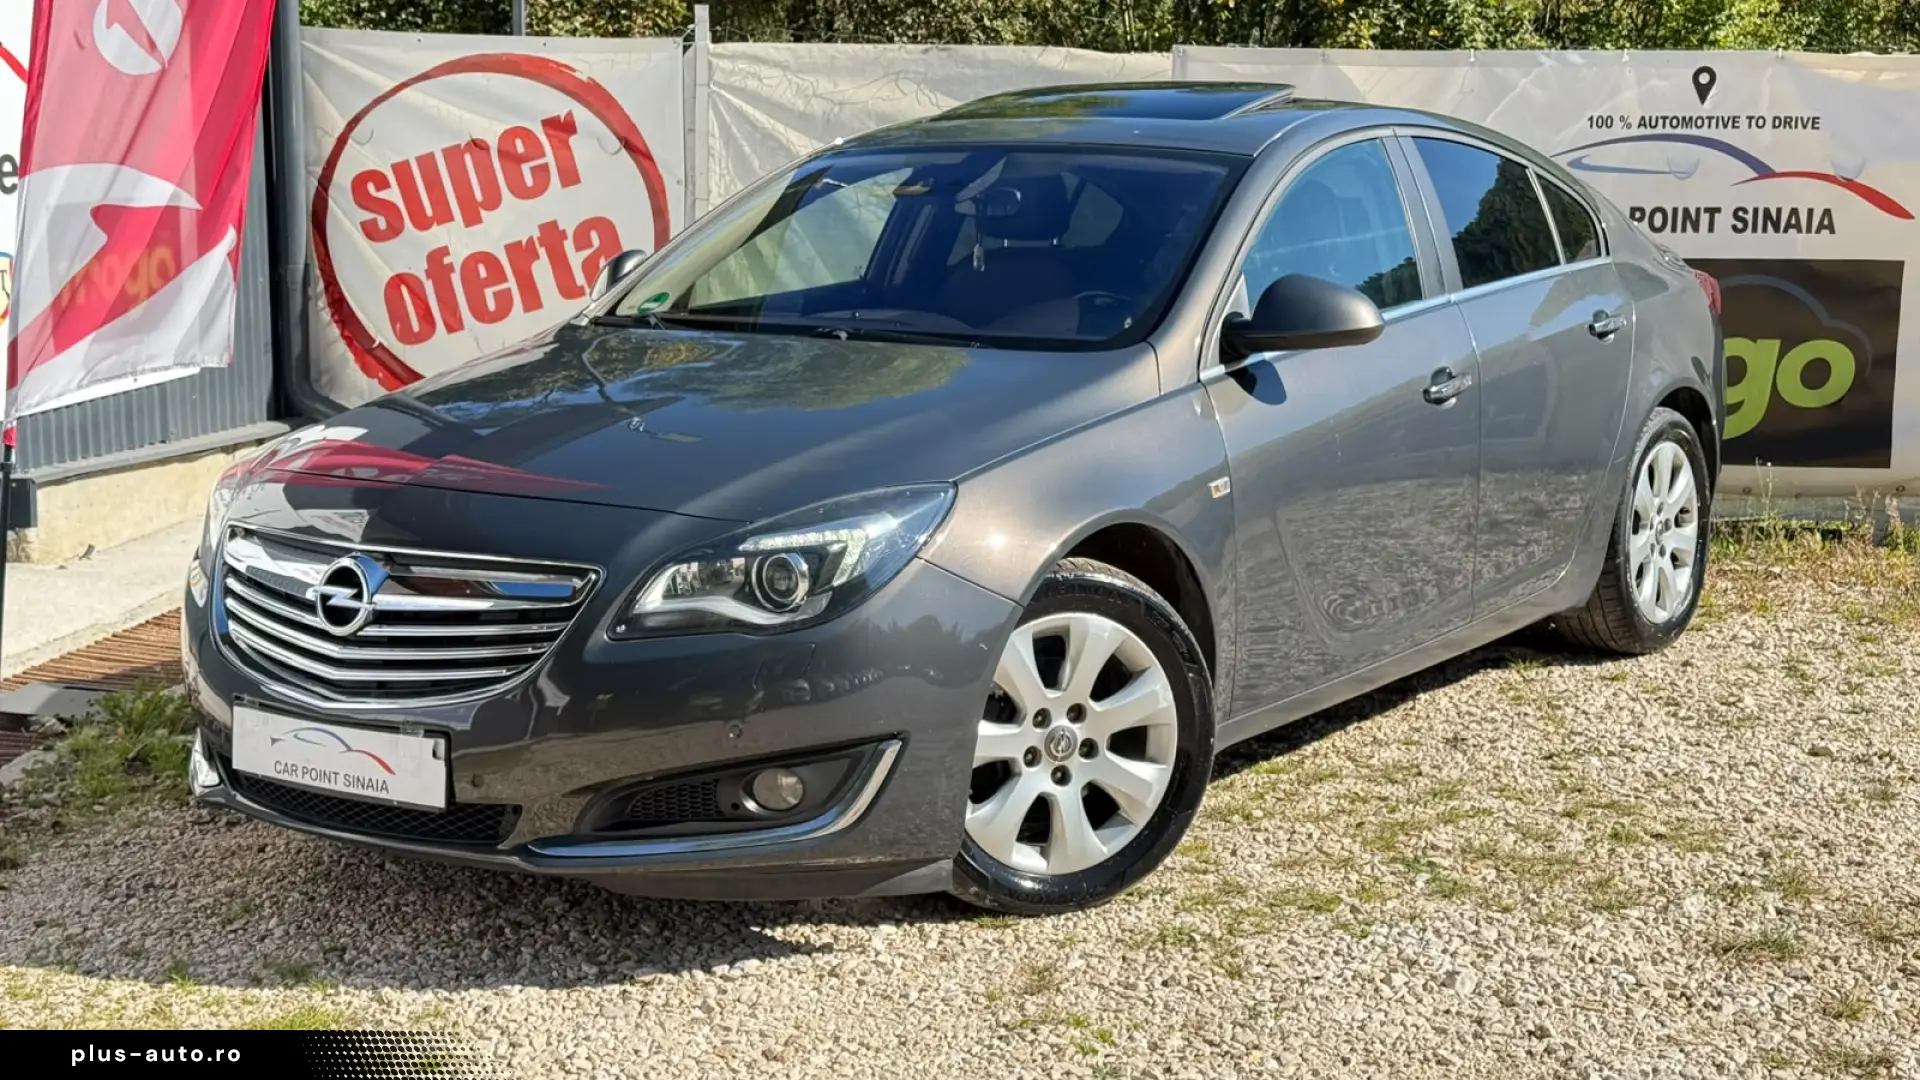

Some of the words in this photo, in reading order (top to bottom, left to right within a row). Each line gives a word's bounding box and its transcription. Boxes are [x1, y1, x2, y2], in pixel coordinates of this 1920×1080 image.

[1587, 115, 1614, 130] 100
[1618, 115, 1632, 130] %
[1637, 115, 1740, 130] AUTOMOTIVE
[1745, 115, 1766, 130] TO
[1771, 116, 1820, 131] DRIVE
[350, 109, 582, 243] super
[1731, 206, 1837, 235] SINAIA
[383, 215, 624, 345] oferta
[274, 760, 298, 778] CAR
[302, 765, 340, 786] POINT
[343, 774, 389, 795] SINAIA
